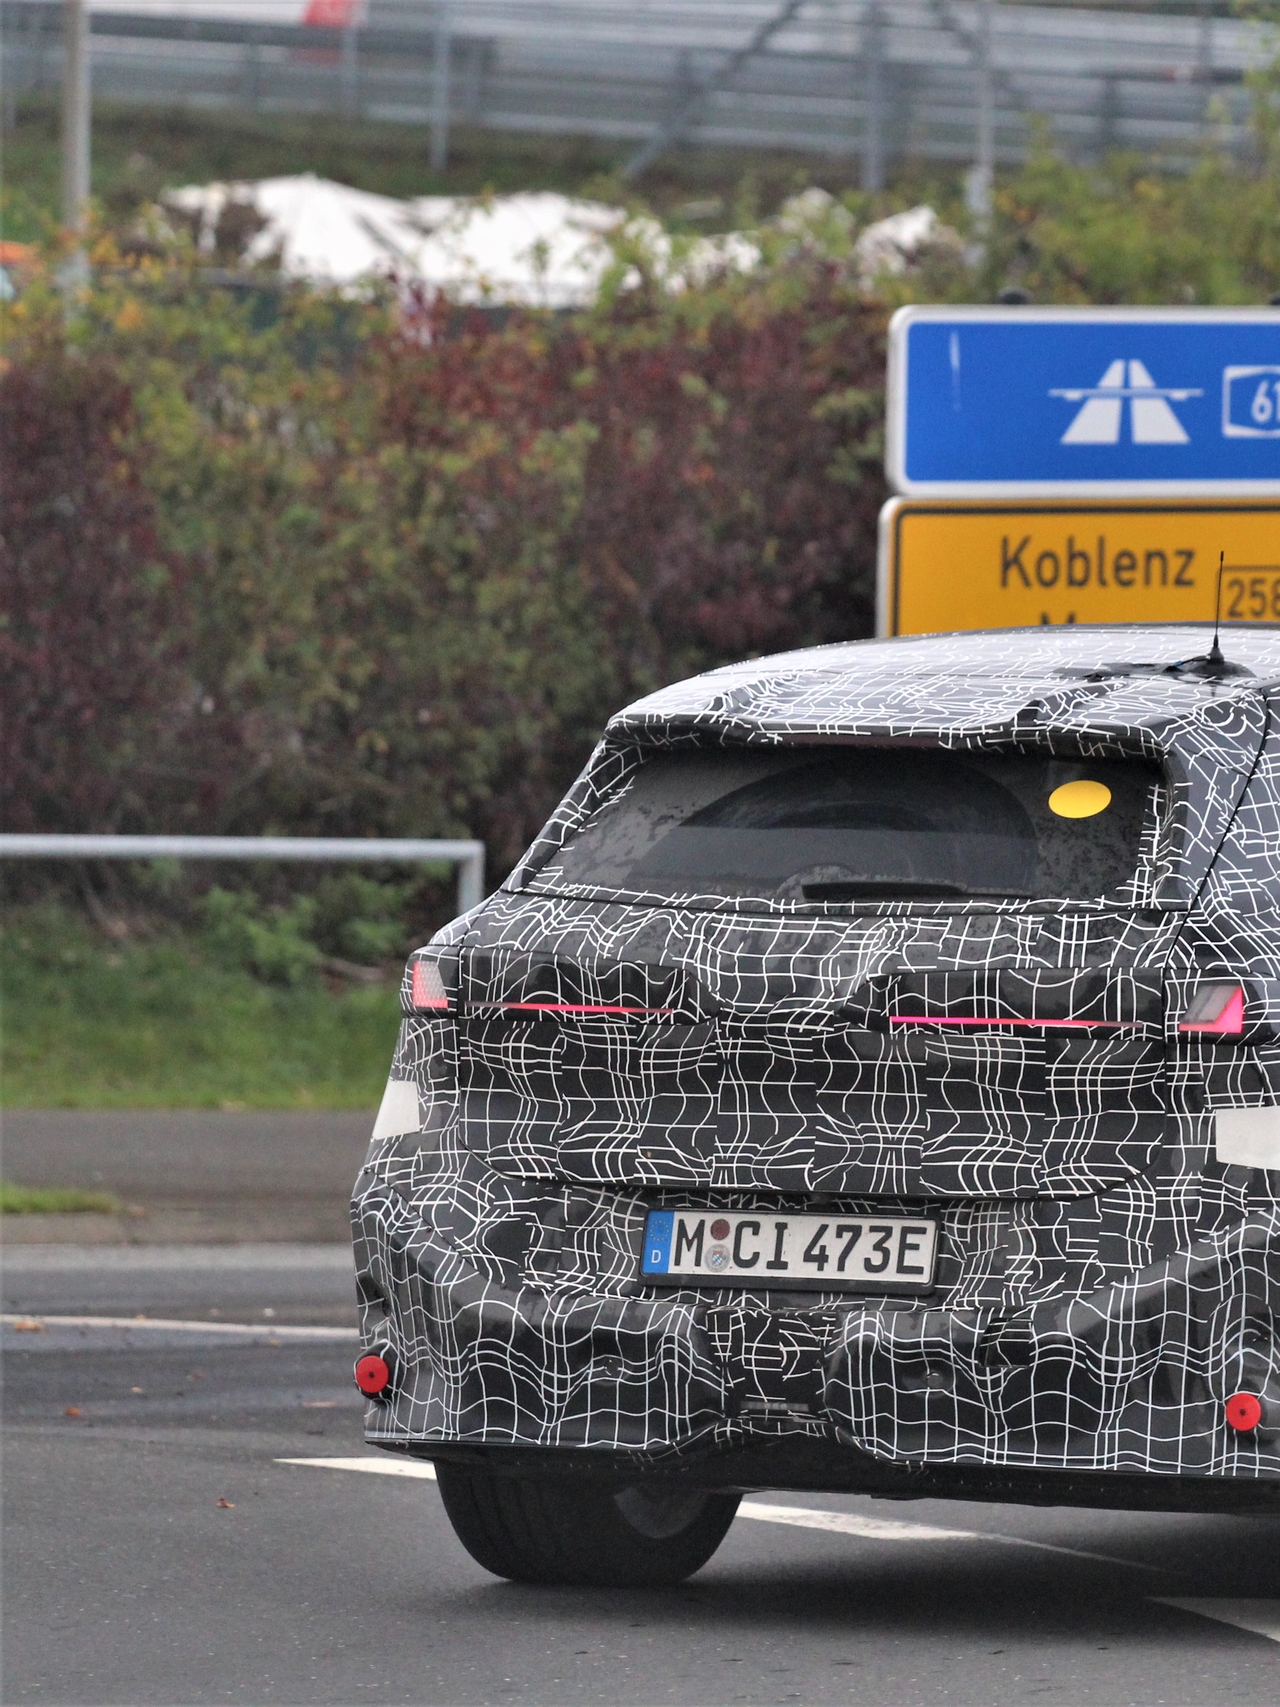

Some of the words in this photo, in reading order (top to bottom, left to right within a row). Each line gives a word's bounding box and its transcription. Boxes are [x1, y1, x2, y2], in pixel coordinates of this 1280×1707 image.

[1000, 535, 1196, 589] Koblenz
[650, 1249, 662, 1264] D
[673, 1218, 706, 1267] M
[732, 1220, 789, 1270] CI
[802, 1223, 928, 1275] 473E
